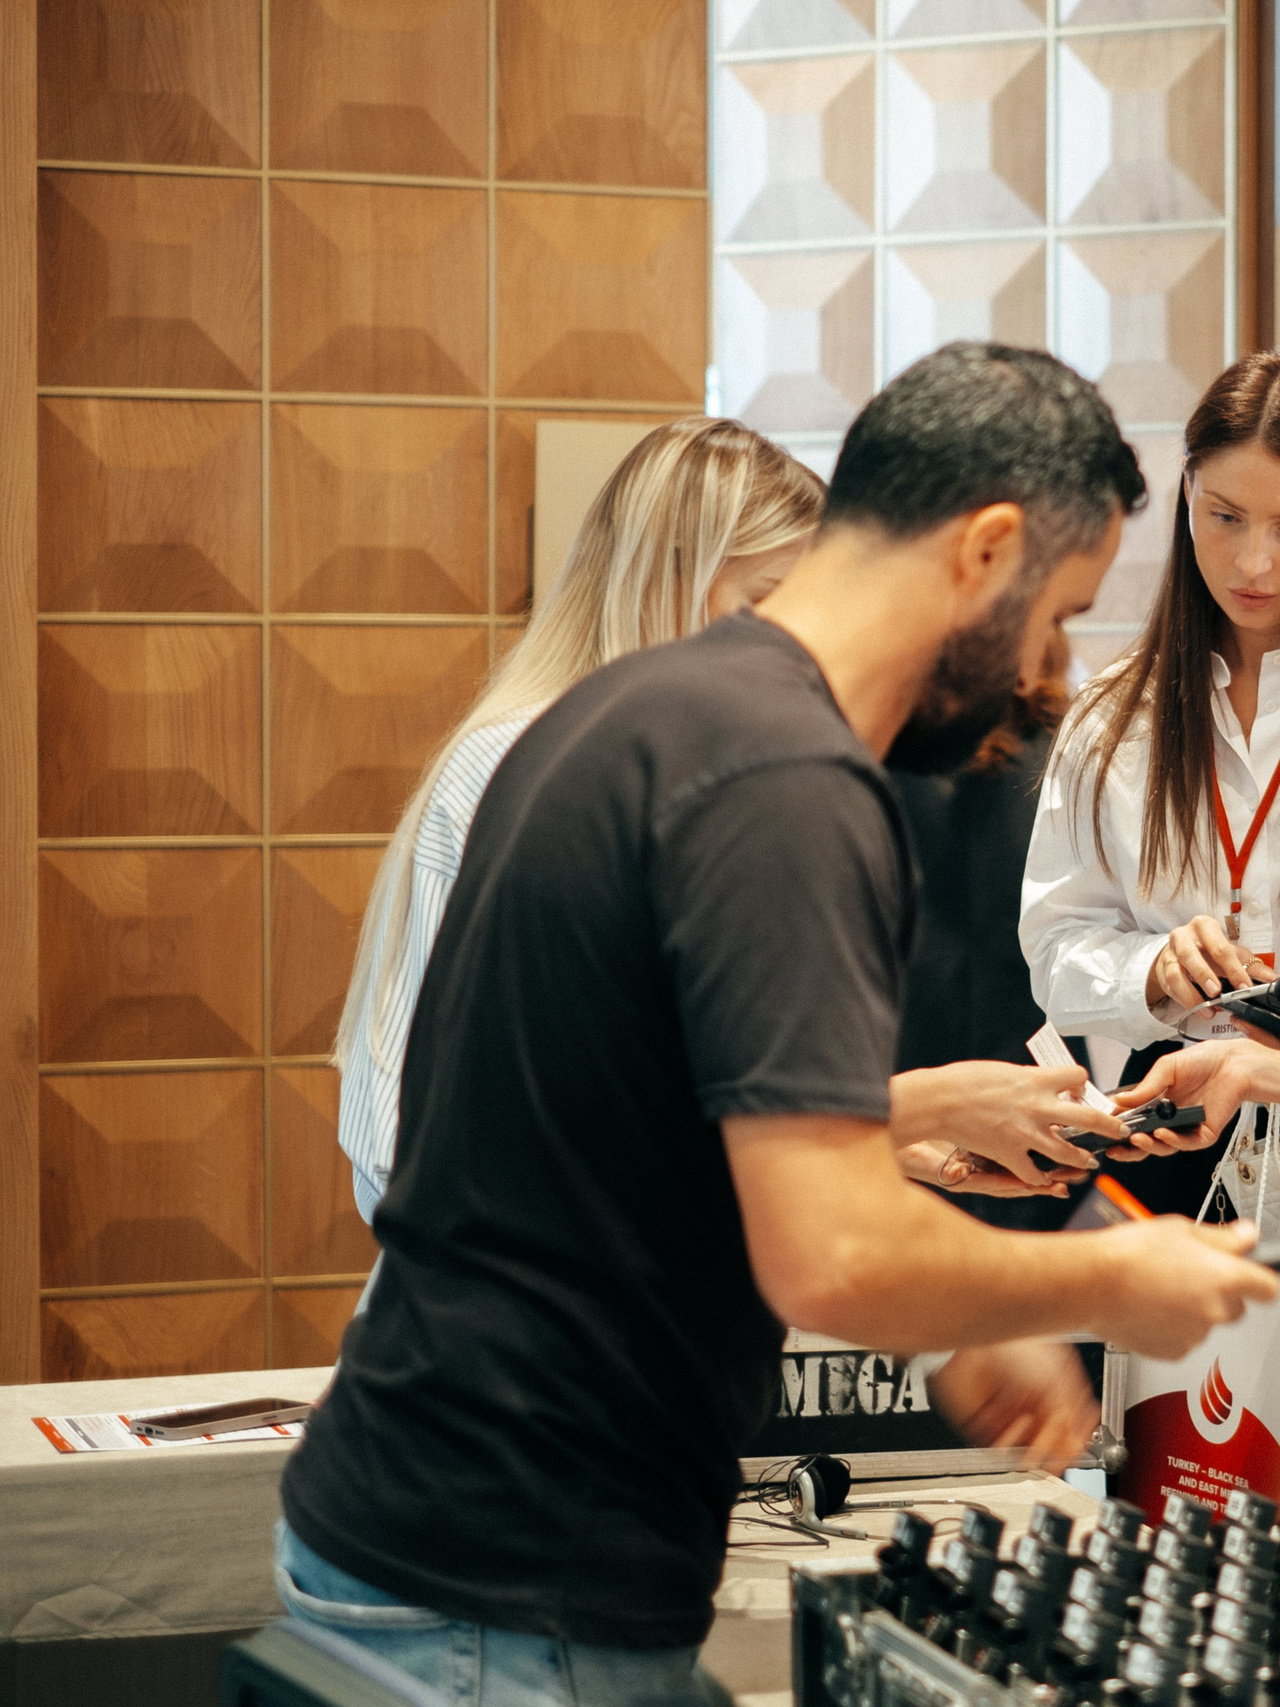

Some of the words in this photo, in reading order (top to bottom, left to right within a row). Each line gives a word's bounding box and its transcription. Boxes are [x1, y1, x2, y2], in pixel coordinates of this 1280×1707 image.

[1211, 1024, 1239, 1034] KRISTIN
[777, 1353, 930, 1417] MEGA
[1167, 1455, 1200, 1474] TURKEY
[1208, 1467, 1234, 1486] BLACK
[1234, 1476, 1249, 1490] SEA
[1178, 1475, 1197, 1489] AND
[1199, 1480, 1219, 1496] EAST
[1201, 1497, 1218, 1511] AND
